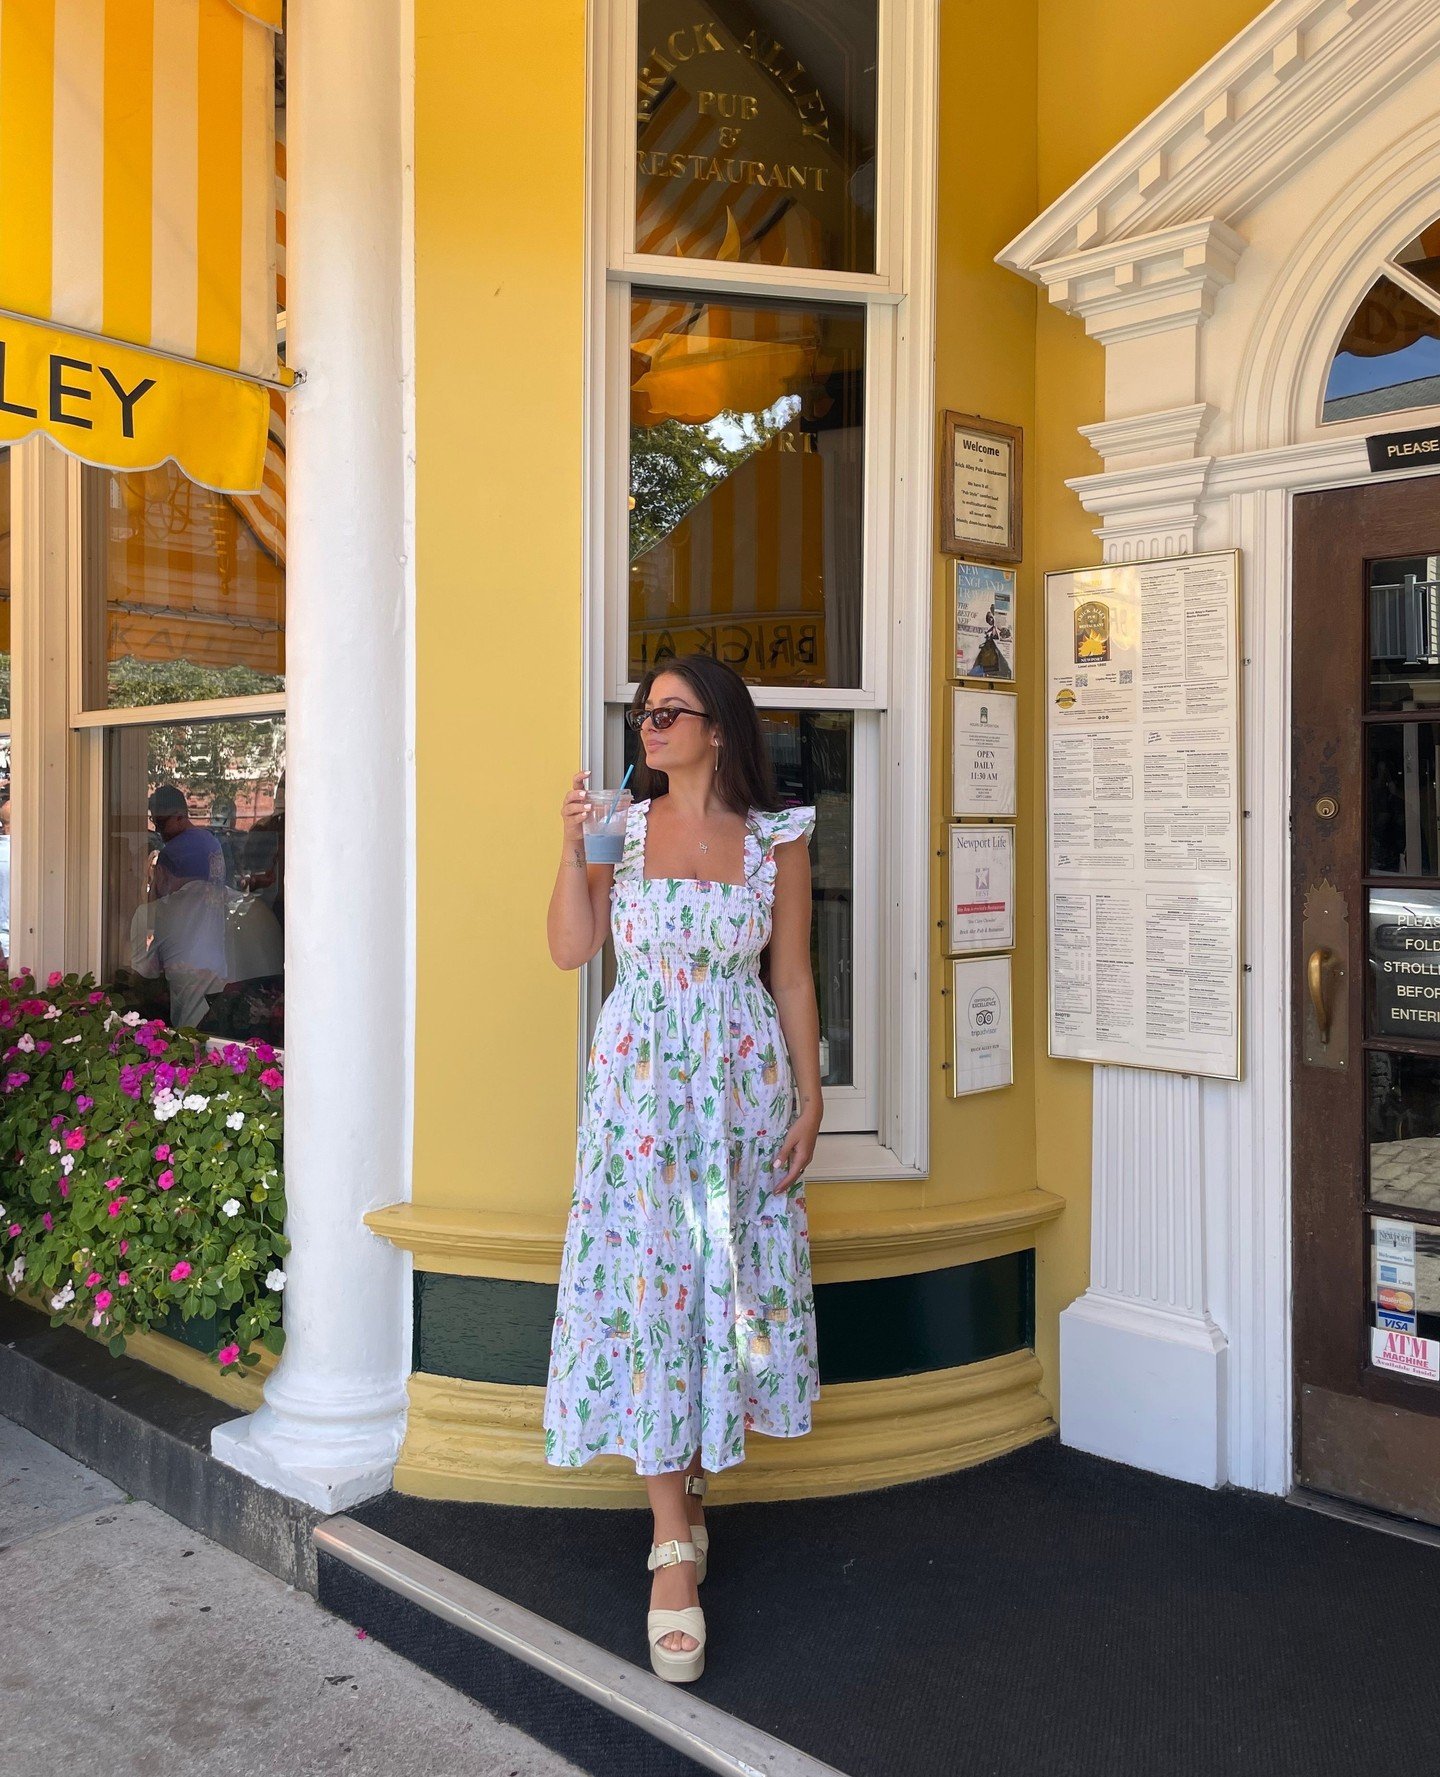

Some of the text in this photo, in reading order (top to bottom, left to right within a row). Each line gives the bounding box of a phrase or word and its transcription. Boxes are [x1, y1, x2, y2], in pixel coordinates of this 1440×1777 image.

[697, 90, 759, 120] PUB
[718, 126, 742, 148] &
[636, 150, 829, 192] RESTAURANT
[963, 439, 1000, 456] Welcome
[1387, 440, 1440, 458] PLEASE
[959, 564, 979, 575] NEW
[958, 574, 1004, 592] ENGLAND
[977, 750, 995, 758] OPEN
[974, 761, 995, 770] DAILY
[970, 772, 986, 780] 11:30
[957, 835, 1007, 852] Newport Life
[1405, 939, 1440, 951] FOLD
[1383, 961, 1440, 975] STROLL
[1379, 1231, 1412, 1244] NEWPORT
[1380, 1295, 1413, 1306] MasterCard
[1385, 1319, 1408, 1331] VISA
[1384, 1332, 1427, 1360] ATM
[1375, 1359, 1436, 1377] Available Inside
[1383, 1351, 1429, 1368] MACHINE
